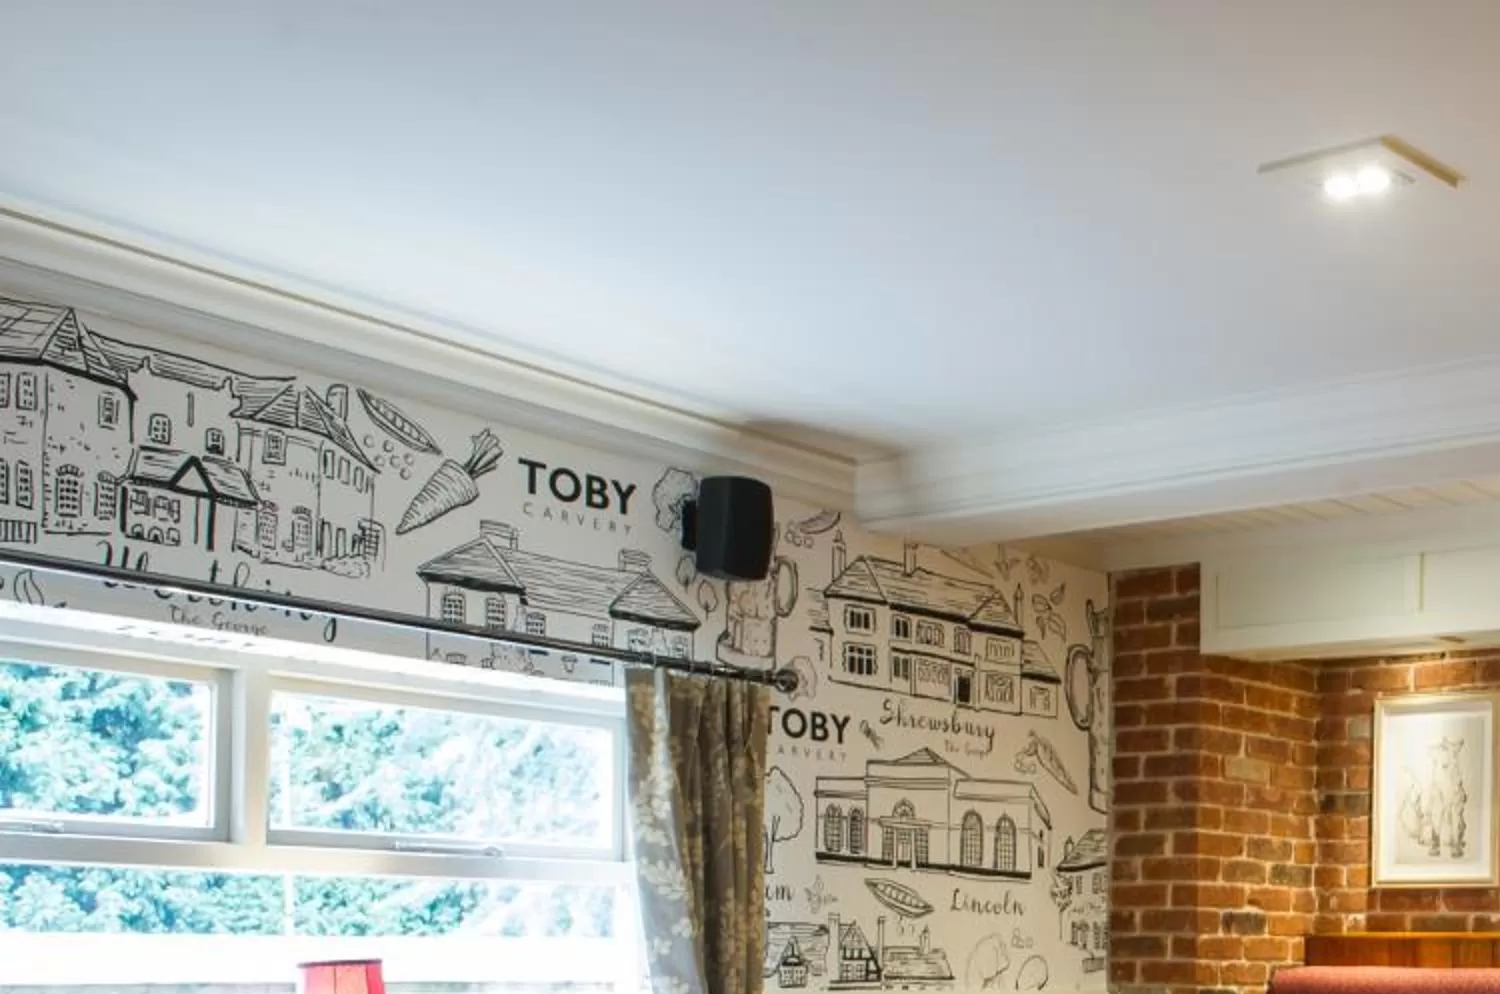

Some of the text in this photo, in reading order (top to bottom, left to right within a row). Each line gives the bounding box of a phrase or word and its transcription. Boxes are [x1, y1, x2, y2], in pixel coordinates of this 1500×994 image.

[518, 457, 637, 515] TOBY
[523, 501, 633, 535] CARVERY
[767, 705, 851, 745] TOBY
[879, 698, 995, 753] Shrewsbury
[777, 745, 848, 763] ARVERY
[950, 887, 1025, 917] Lincoln
